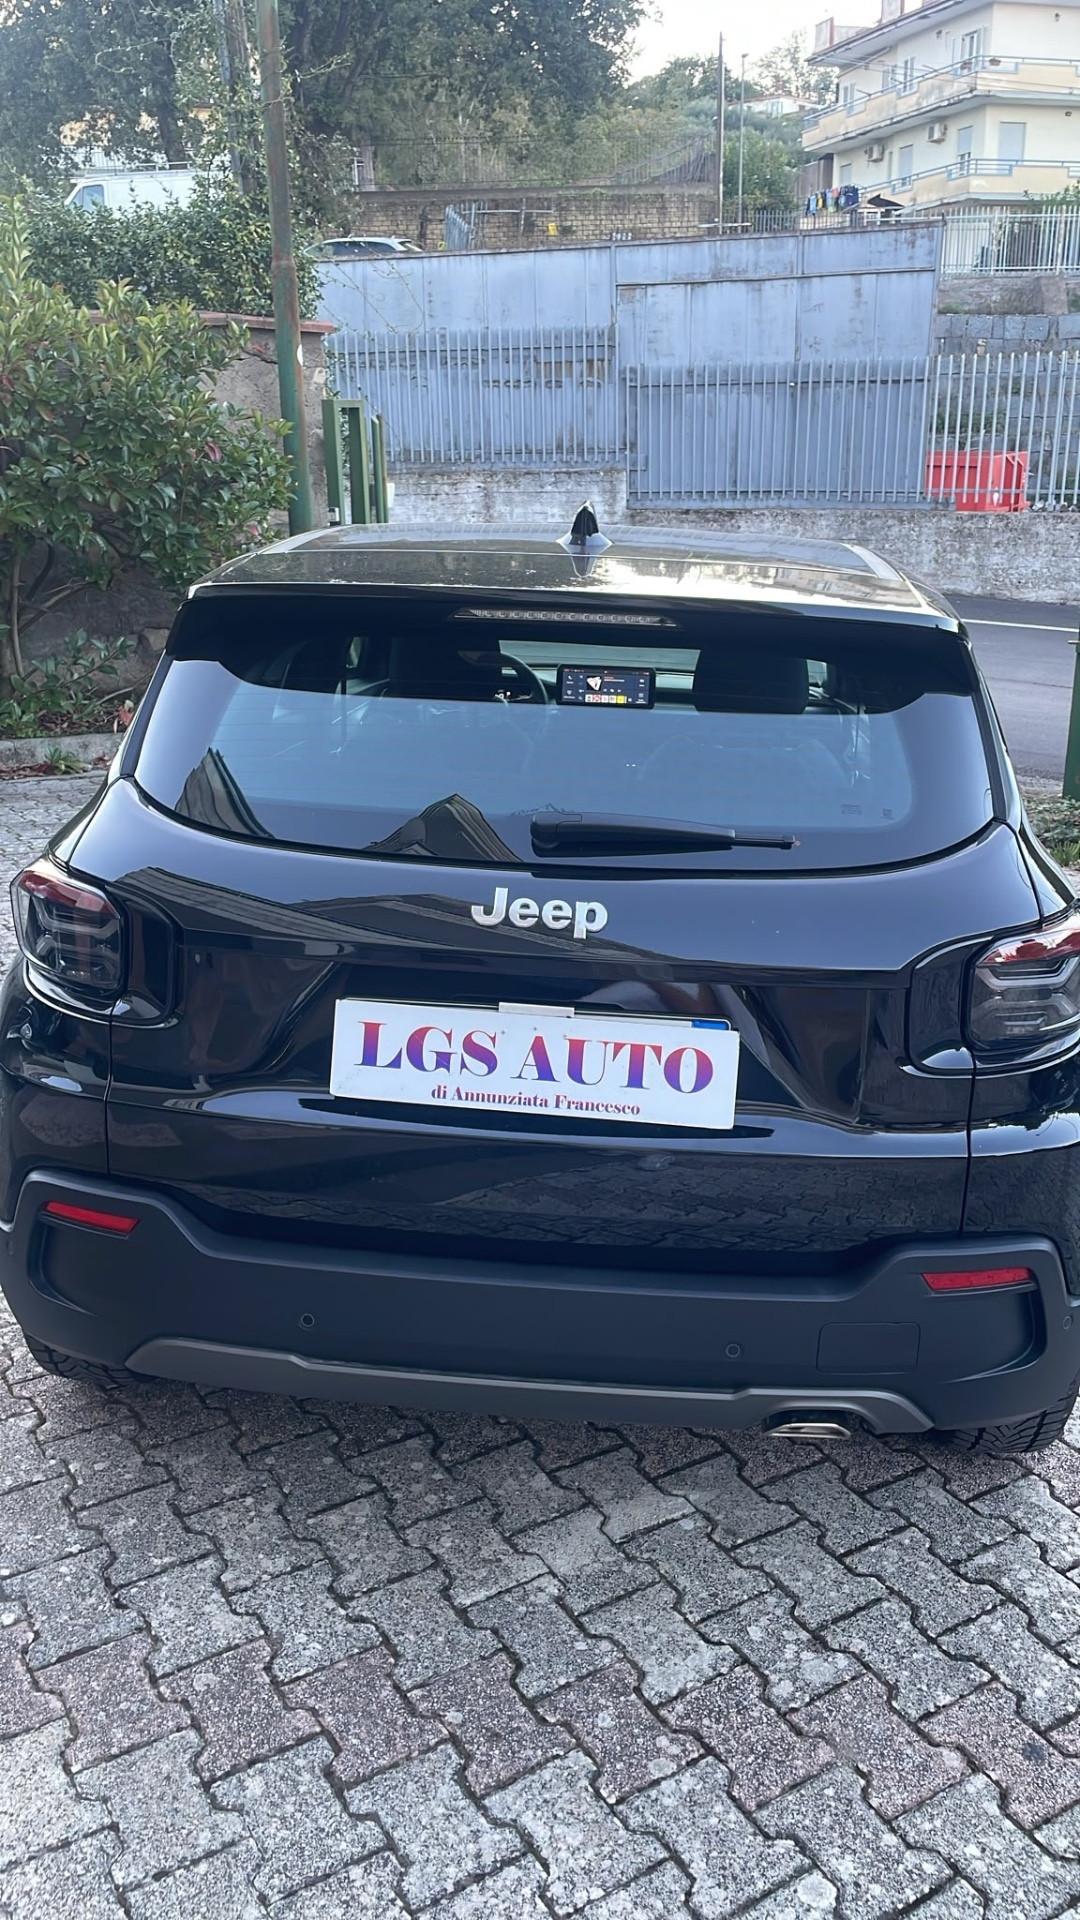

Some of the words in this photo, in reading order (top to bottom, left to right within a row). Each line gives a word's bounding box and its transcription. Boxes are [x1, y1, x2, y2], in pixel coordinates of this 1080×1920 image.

[471, 887, 608, 939] Jeep
[353, 1021, 498, 1077] LGS
[511, 1035, 714, 1093] AUTO
[431, 1085, 447, 1099] di
[453, 1087, 549, 1108] Annunziata
[554, 1095, 640, 1115] Francesco
